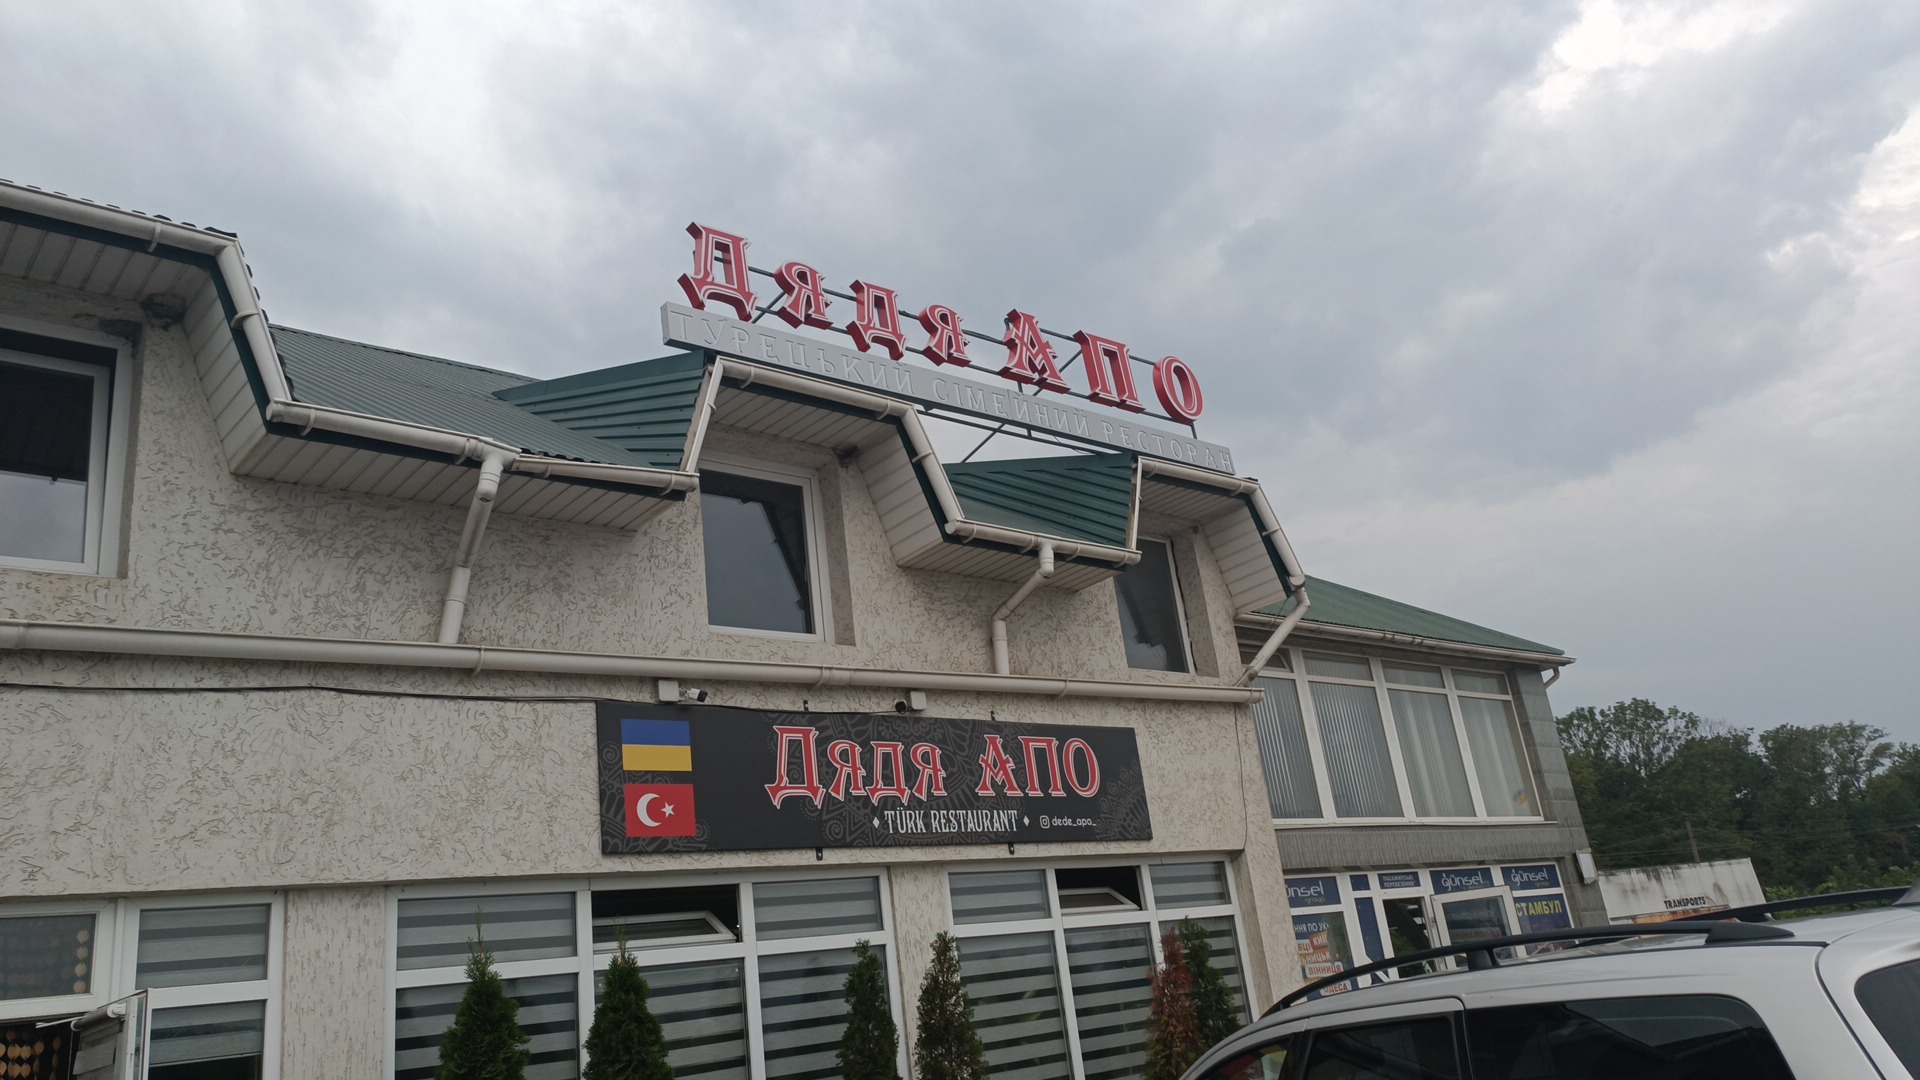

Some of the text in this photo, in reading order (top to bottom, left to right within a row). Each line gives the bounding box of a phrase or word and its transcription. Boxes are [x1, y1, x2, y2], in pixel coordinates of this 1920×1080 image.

[999, 308, 1204, 424] АПО
[670, 310, 1236, 474] ТУРЕЦЬКИЙ СІМЕЙНИЙ РЕСТОРАН
[975, 734, 1101, 797] АПО
[884, 807, 1018, 834] TÜRK RESTAURANT
[1052, 815, 1097, 828] dede_apo_
[1664, 896, 1706, 909] TRANSPORTS
[1308, 964, 1341, 976] ВІННИЦЯ
